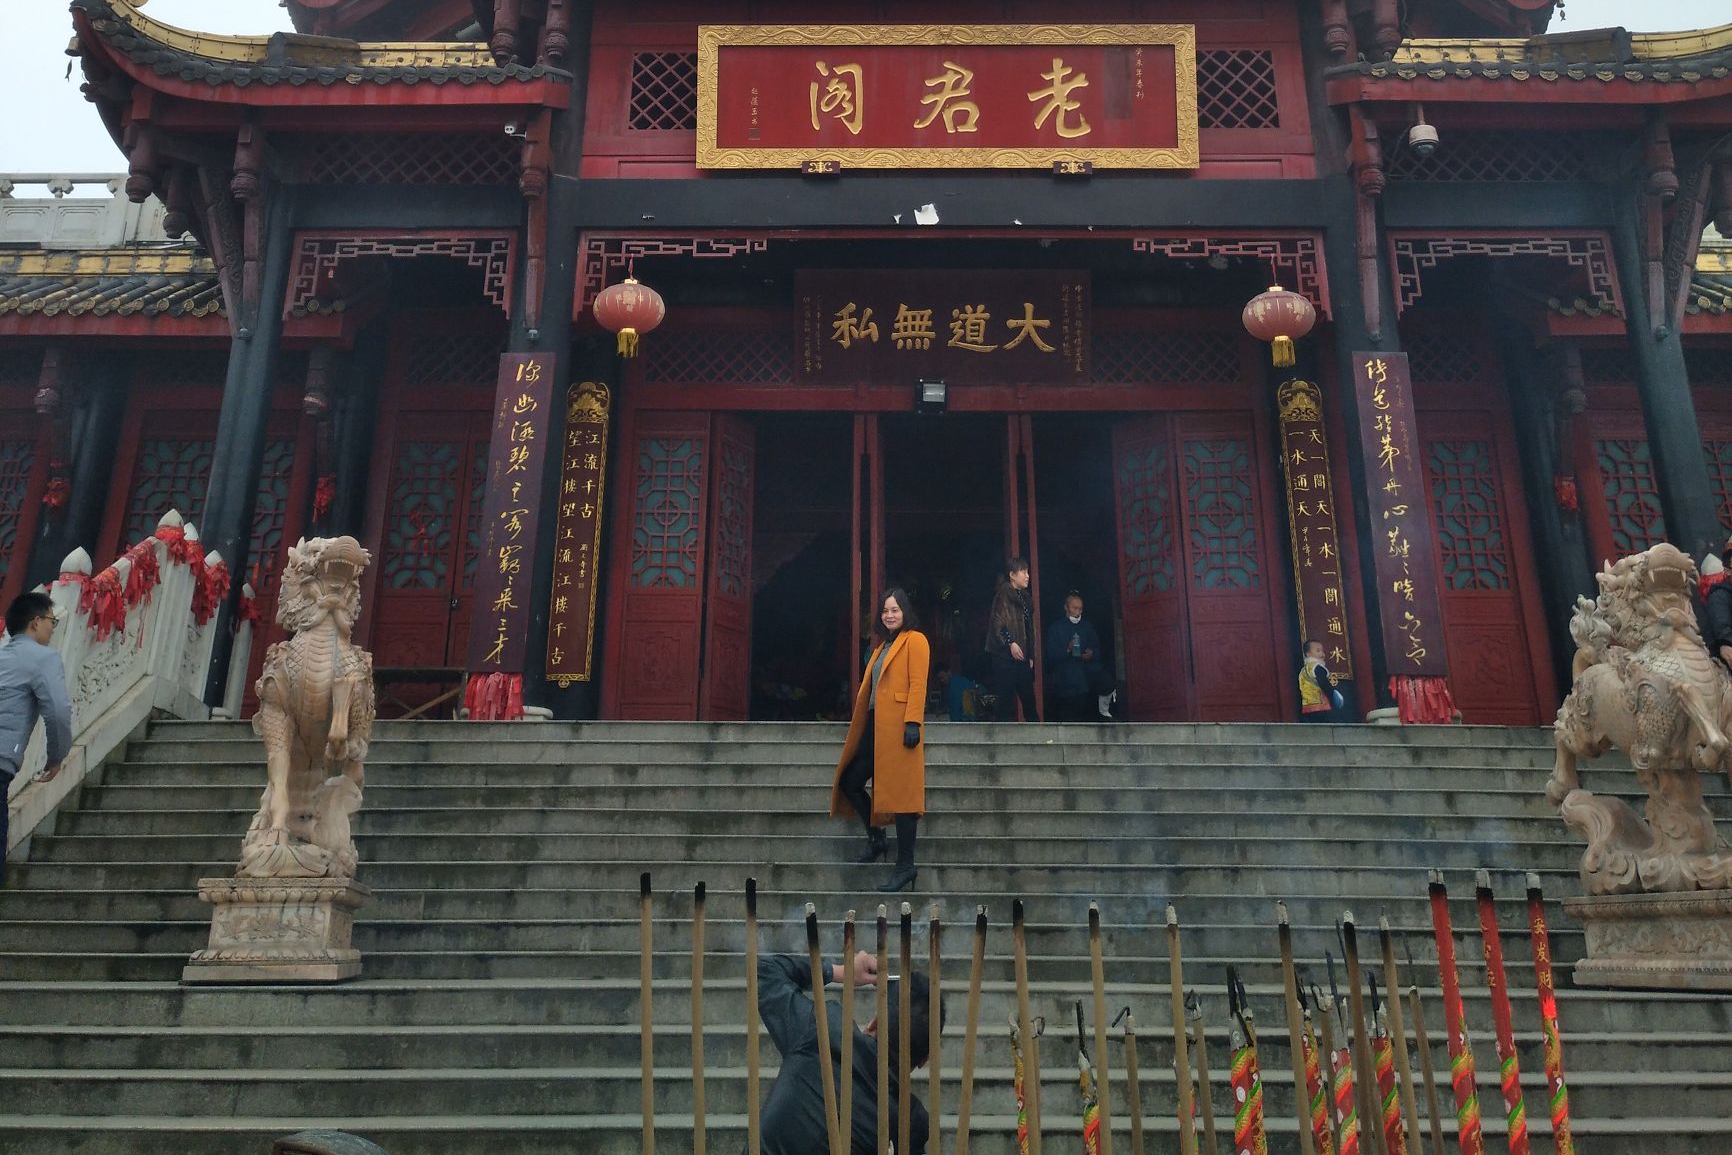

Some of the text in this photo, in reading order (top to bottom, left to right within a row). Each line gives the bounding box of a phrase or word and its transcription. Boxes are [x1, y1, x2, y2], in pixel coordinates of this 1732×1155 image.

[830, 301, 1057, 353] 大道無私
[1288, 430, 1312, 518] 一水通天
